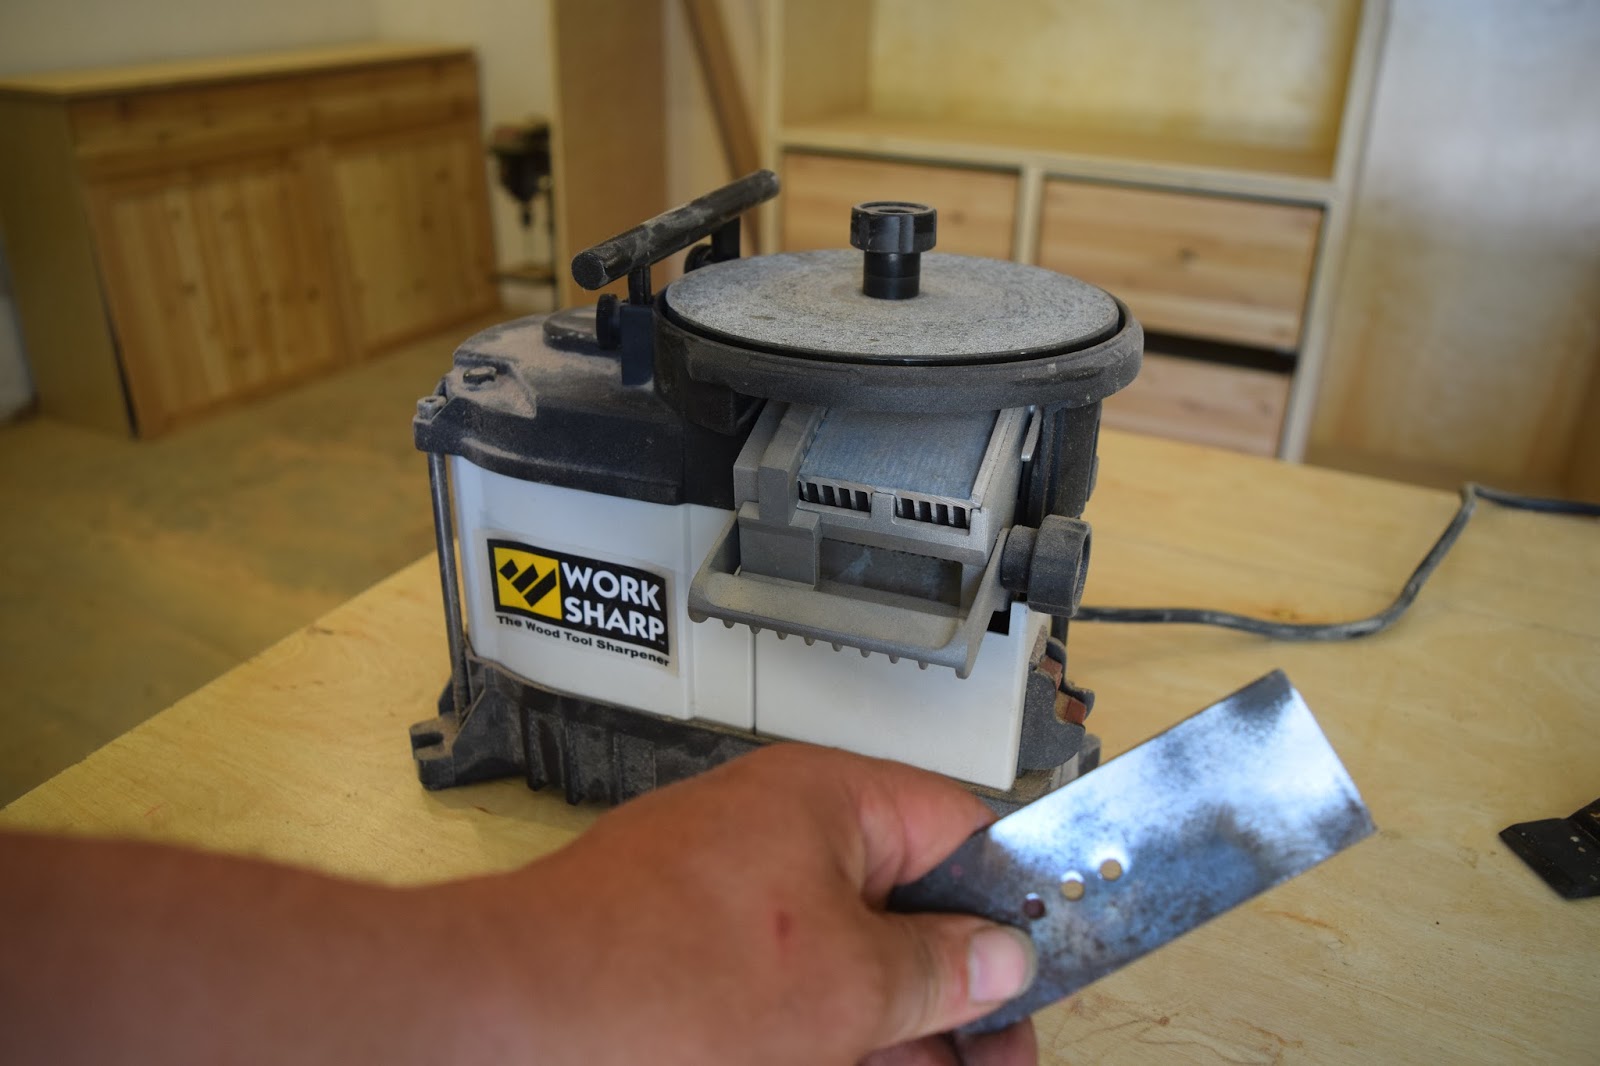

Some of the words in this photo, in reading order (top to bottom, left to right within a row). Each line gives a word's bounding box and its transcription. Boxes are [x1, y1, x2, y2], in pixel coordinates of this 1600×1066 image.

[561, 562, 661, 611] WORK
[496, 615, 522, 628] The
[525, 620, 560, 639] Wood
[564, 631, 592, 647] Tool
[596, 639, 670, 667] Sharpener
[564, 596, 665, 641] SHARP
